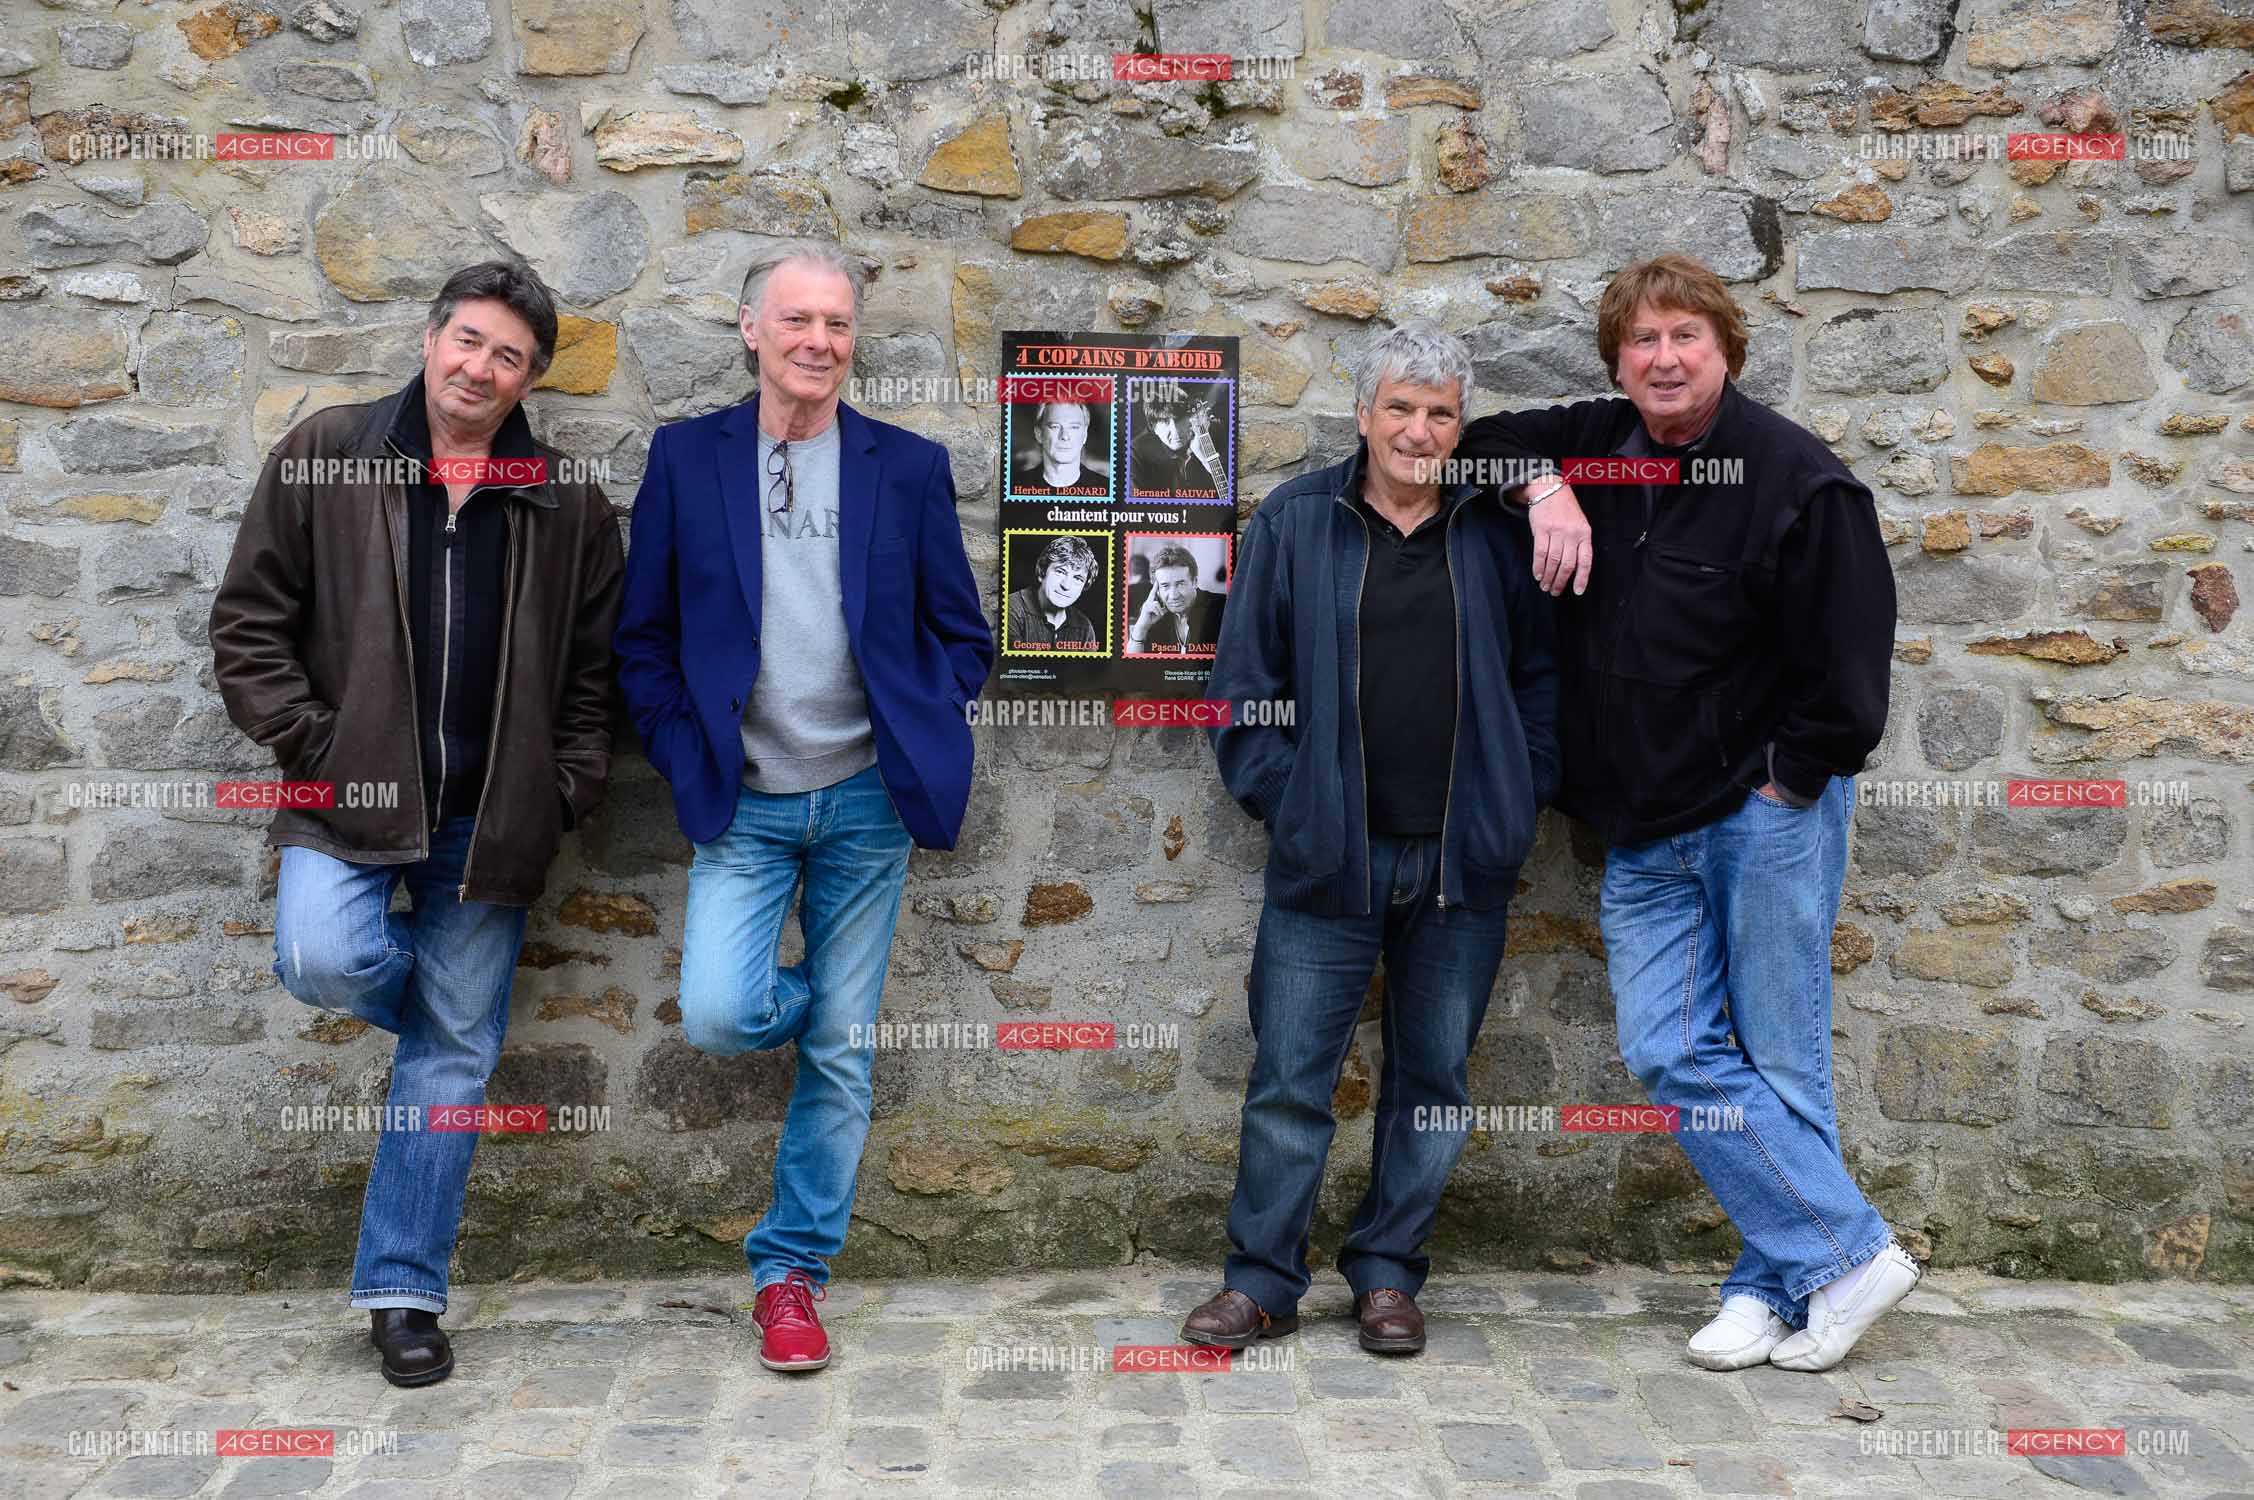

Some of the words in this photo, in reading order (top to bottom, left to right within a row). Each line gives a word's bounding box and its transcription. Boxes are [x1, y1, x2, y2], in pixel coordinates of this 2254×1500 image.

[1016, 348, 1028, 365] 4
[1038, 348, 1126, 367] COPAINS
[1135, 350, 1223, 369] D'ABORD
[1013, 486, 1050, 496] Herbert
[1056, 486, 1107, 497] LEONARD
[1133, 487, 1170, 498] Bernard
[1175, 489, 1216, 499] SAUVAT
[1047, 506, 1108, 523] chantent
[1111, 511, 1145, 526] pour
[1146, 512, 1179, 524] vous
[1013, 640, 1051, 652] Georges
[1055, 640, 1100, 651] CHELON
[1151, 642, 1180, 652] Pascal
[1188, 643, 1216, 652] DANE
